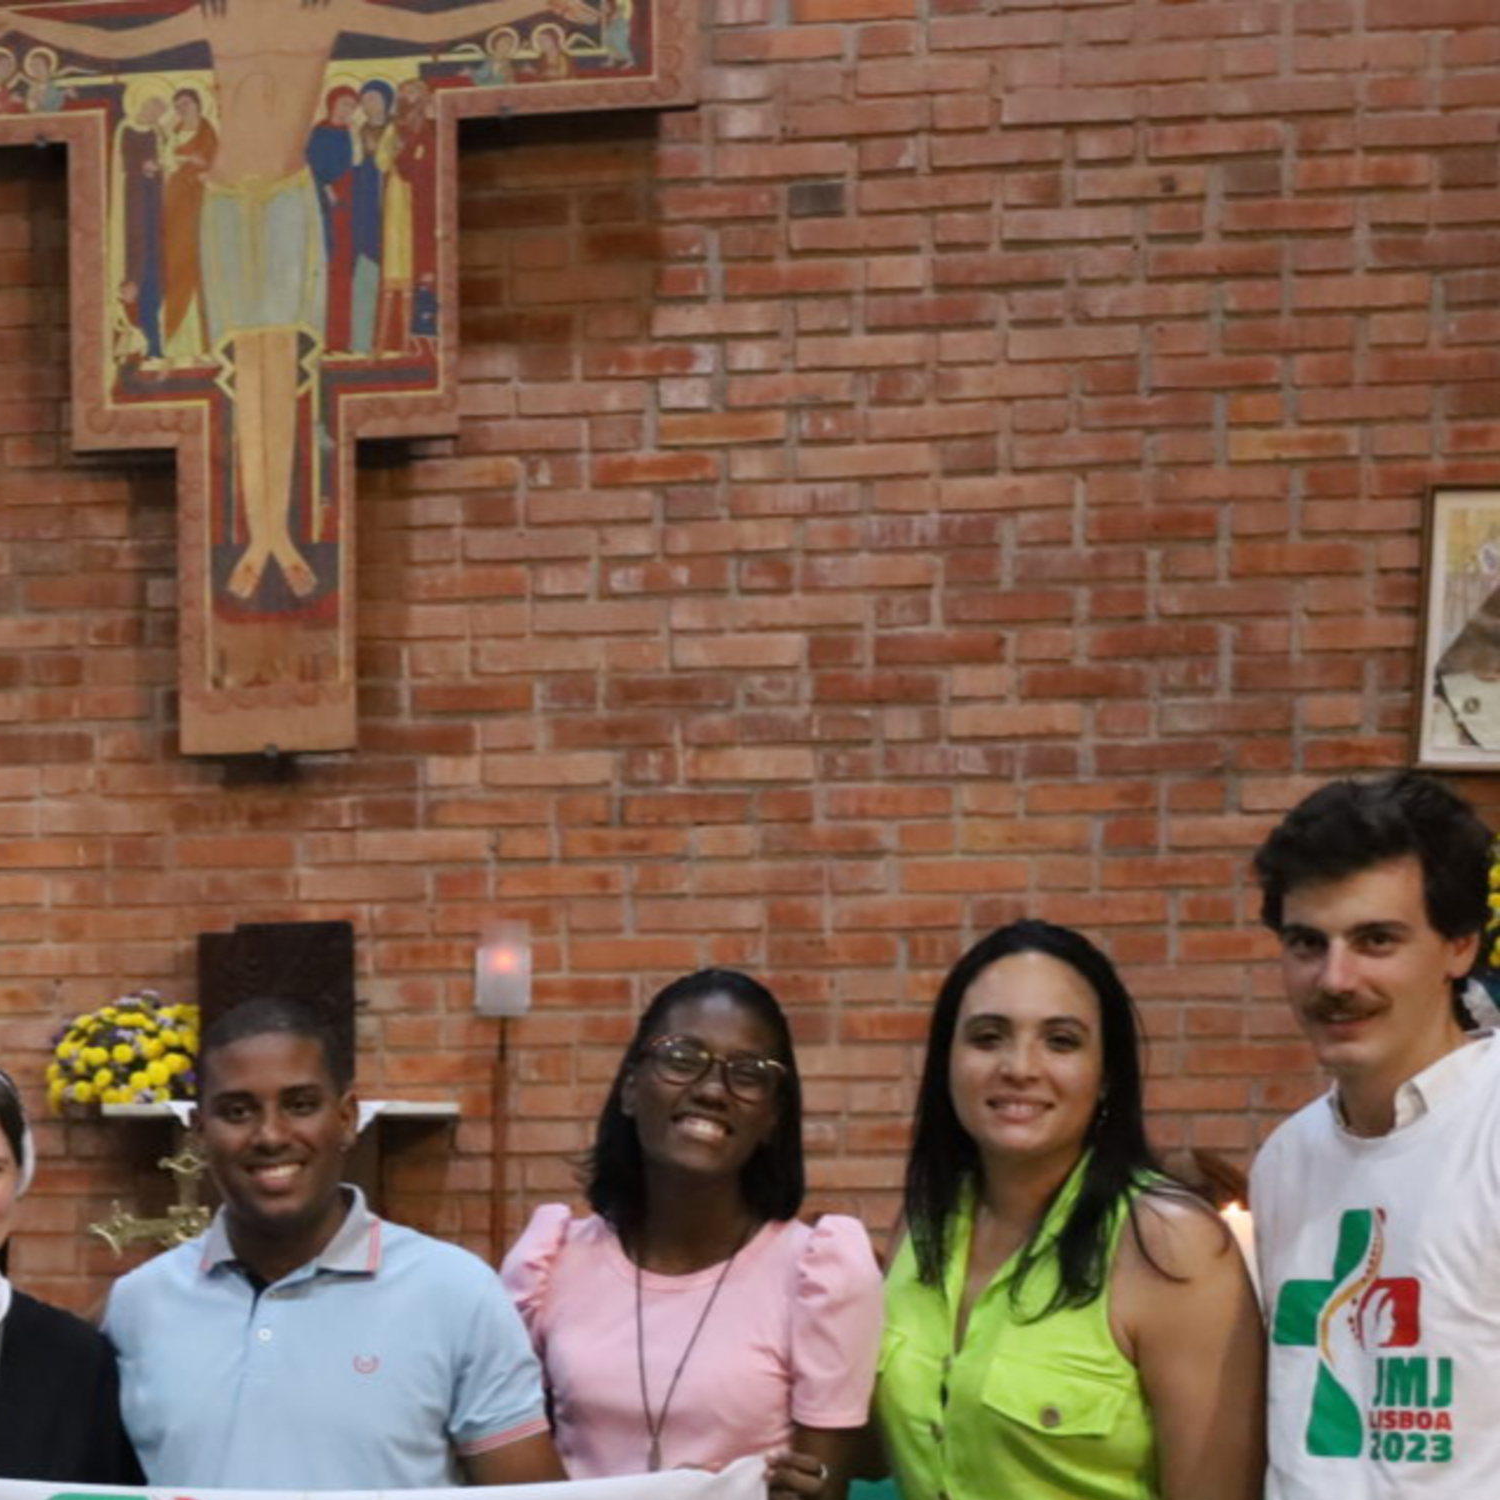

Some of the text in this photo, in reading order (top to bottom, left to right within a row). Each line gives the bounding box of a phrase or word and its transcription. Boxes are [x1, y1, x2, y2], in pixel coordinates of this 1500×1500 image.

[1373, 1356, 1453, 1407] JMJ
[1368, 1410, 1453, 1431] LISBOA
[1370, 1432, 1453, 1463] 2023
